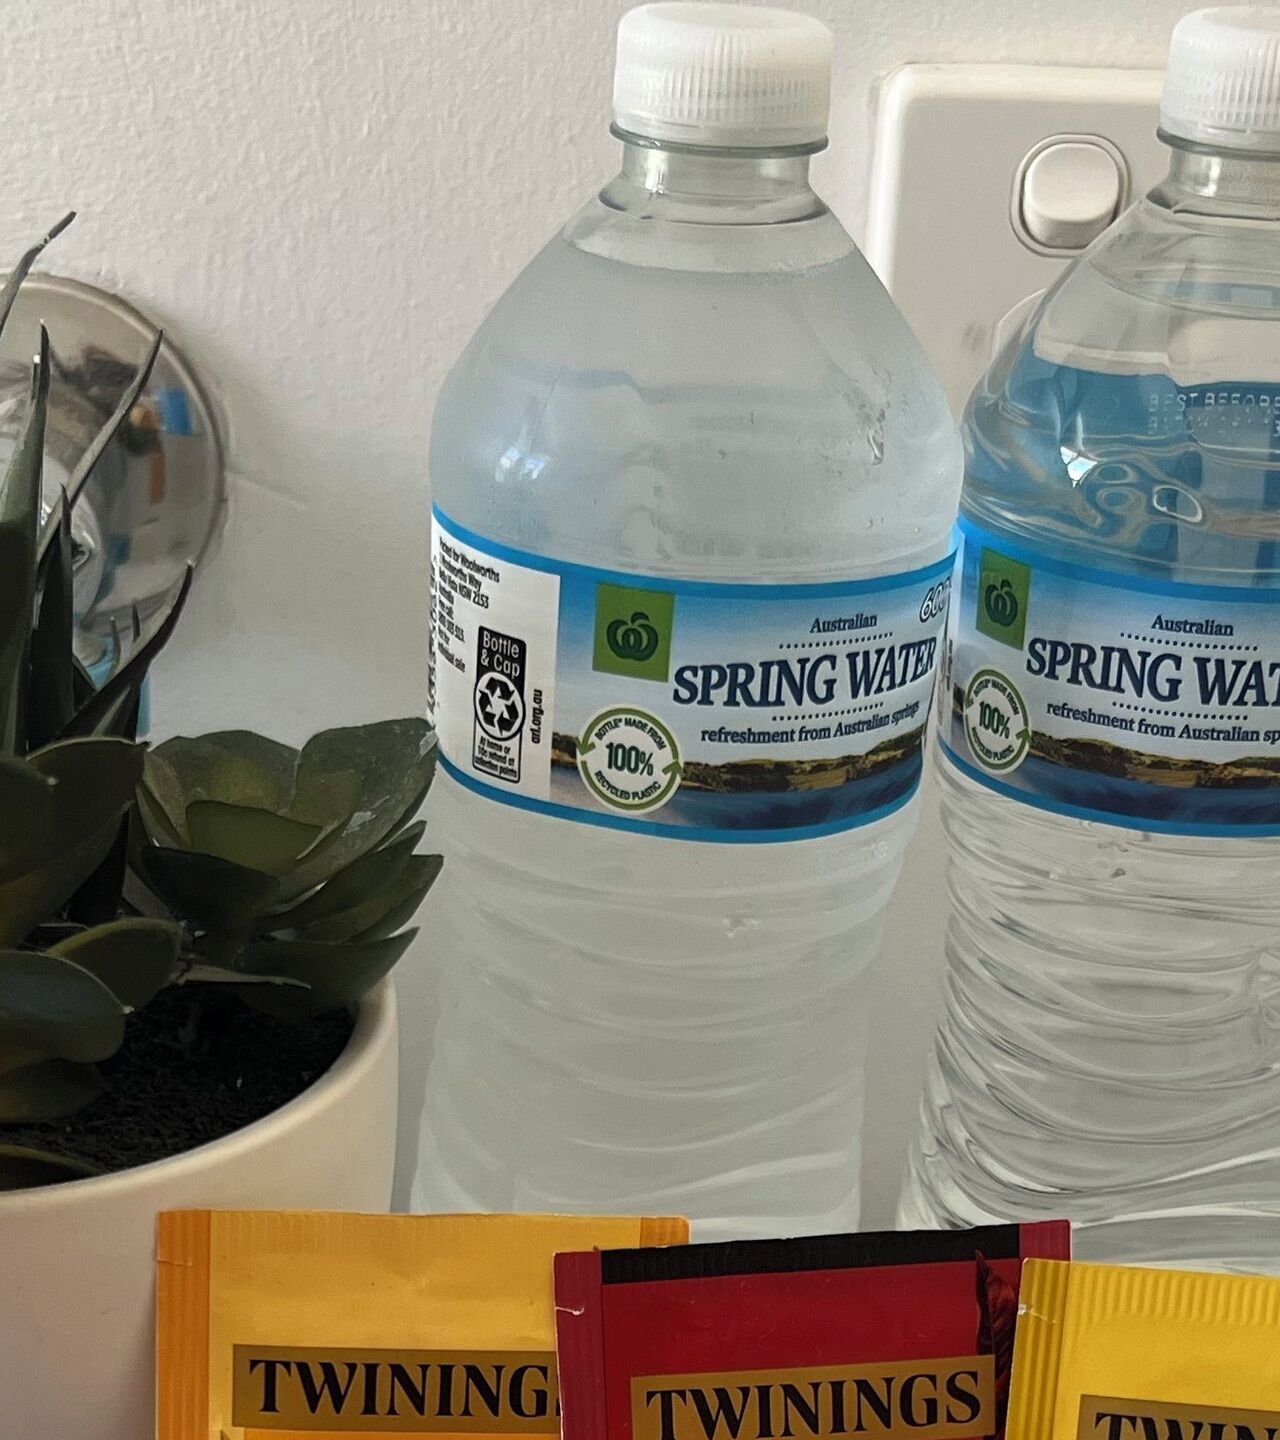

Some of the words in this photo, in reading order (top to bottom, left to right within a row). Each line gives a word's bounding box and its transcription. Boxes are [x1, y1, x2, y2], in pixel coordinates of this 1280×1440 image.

[810, 613, 877, 634] Australian
[1152, 615, 1233, 637] Australian
[483, 630, 519, 658] Bottle
[481, 651, 490, 667] &
[493, 653, 520, 679] Cap
[673, 651, 839, 708] SPRING
[844, 637, 937, 695] WATER
[1026, 638, 1183, 702] SPRING
[531, 689, 543, 744] arl.org.au
[701, 726, 794, 744] refreshment
[797, 722, 831, 742] from
[833, 713, 890, 738] Australian
[892, 700, 921, 730] springs
[979, 701, 1010, 739] 100%
[1046, 702, 1133, 734] refreshment
[1137, 718, 1176, 739] from
[1178, 722, 1259, 742] Australian
[606, 742, 654, 776] 100%
[249, 1357, 560, 1418] TWINING
